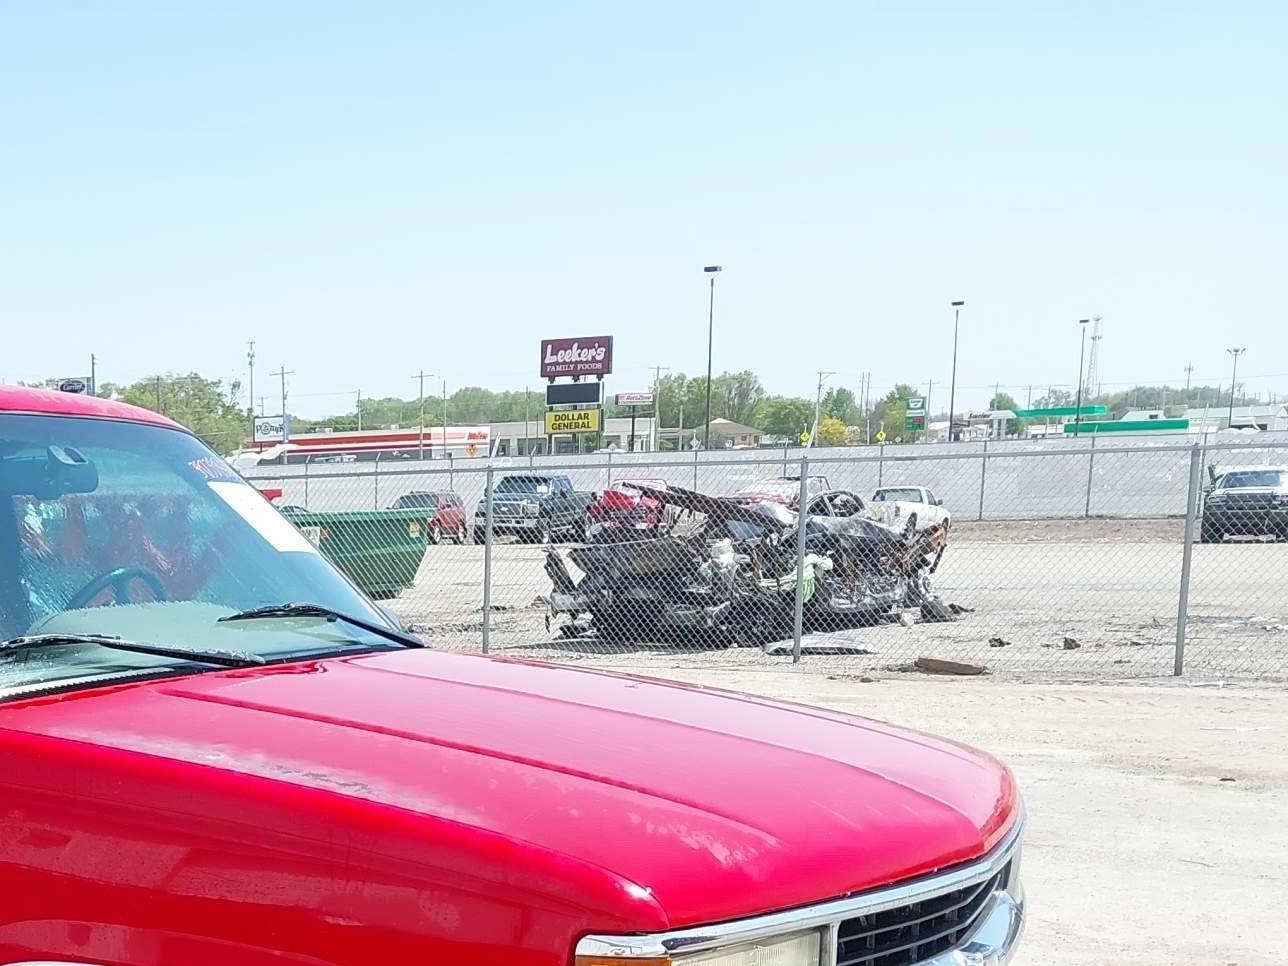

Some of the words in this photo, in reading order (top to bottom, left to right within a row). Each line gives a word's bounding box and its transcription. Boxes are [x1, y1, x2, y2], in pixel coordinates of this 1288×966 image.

[544, 342, 606, 364] Leeker's
[546, 364, 575, 372] FAMILY
[577, 362, 603, 371] FOODS
[554, 412, 590, 422] DOLLAR
[551, 421, 592, 431] GENERAL
